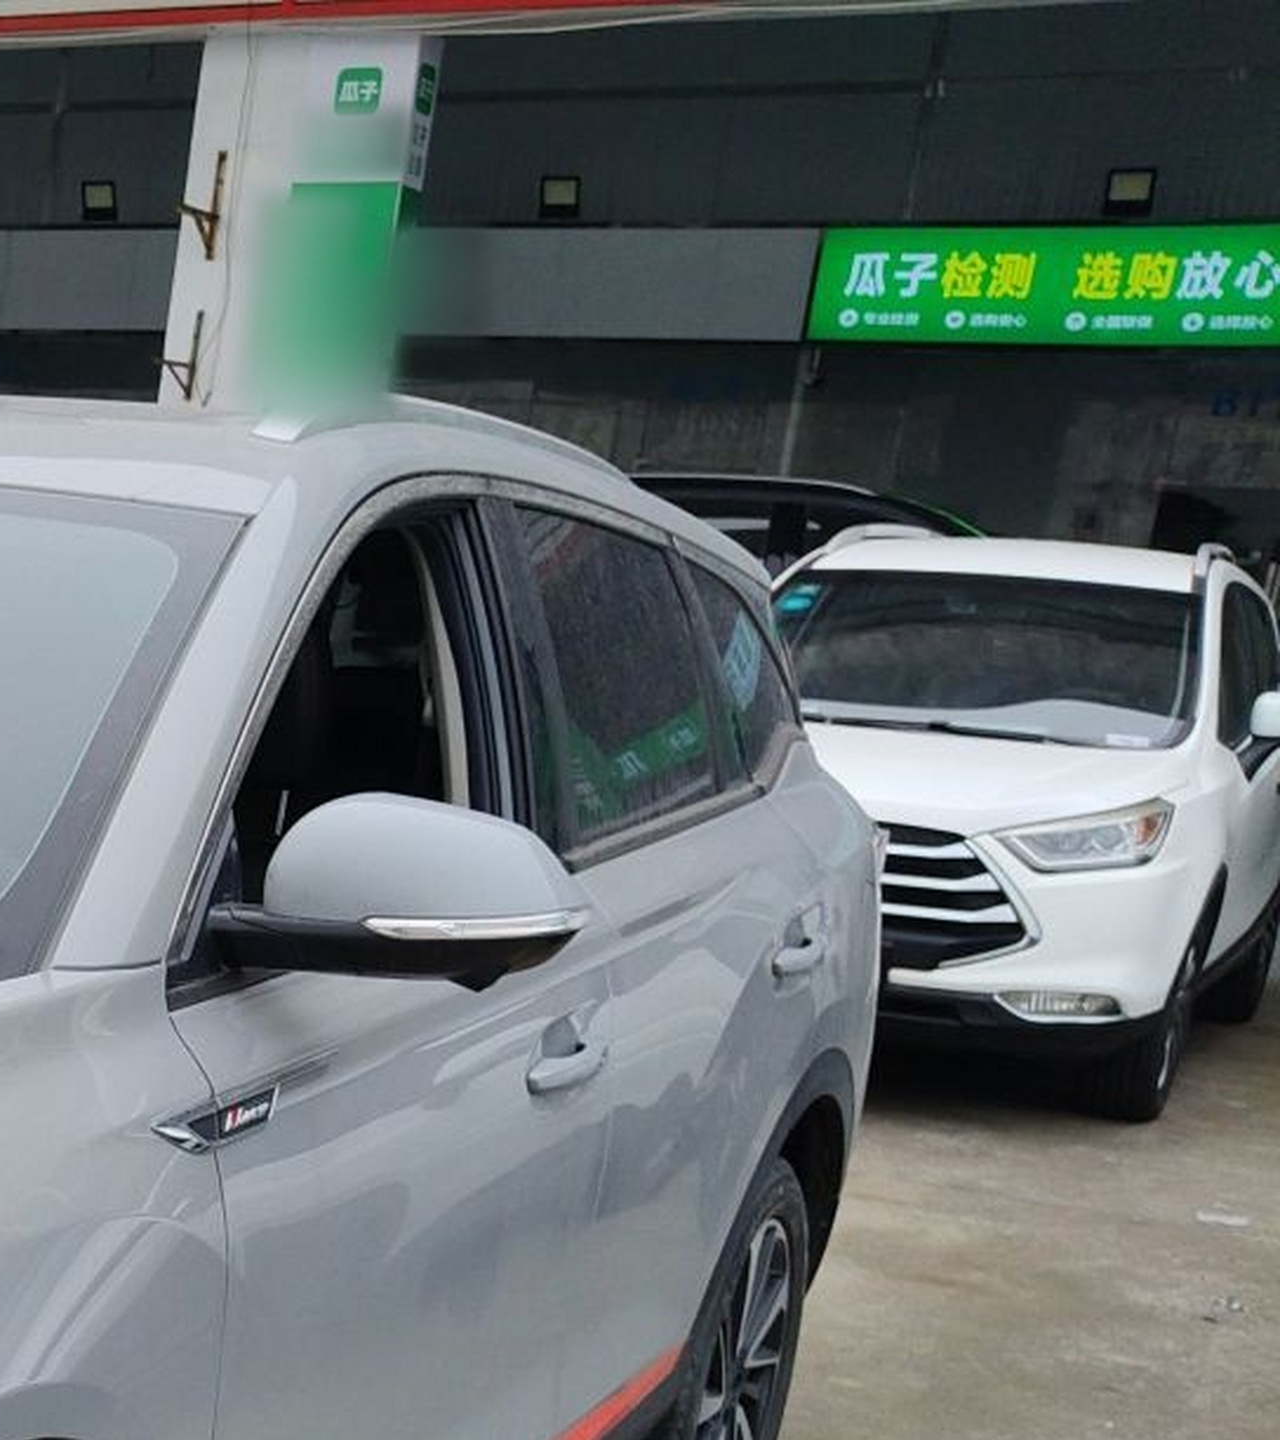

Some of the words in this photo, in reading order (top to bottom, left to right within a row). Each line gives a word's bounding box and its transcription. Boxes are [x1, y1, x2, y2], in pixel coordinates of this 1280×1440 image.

[338, 80, 379, 102] 瓜子
[843, 251, 1037, 299] 瓜子检测
[1072, 250, 1280, 300] 选购放心
